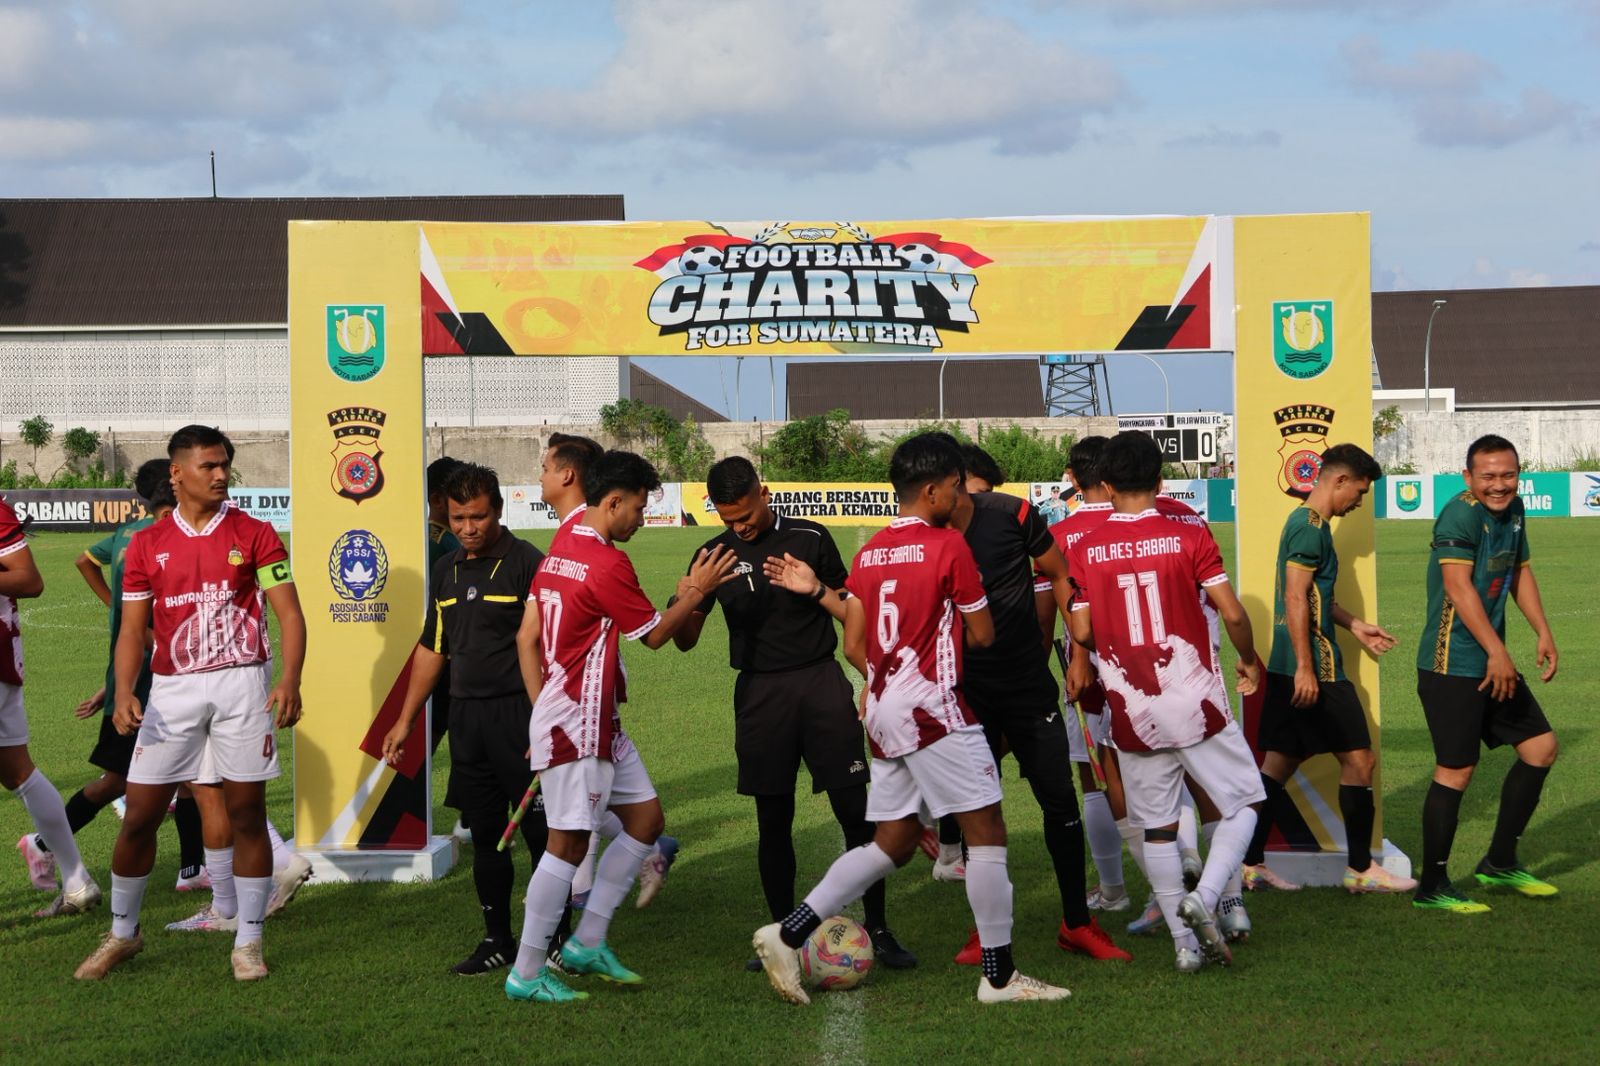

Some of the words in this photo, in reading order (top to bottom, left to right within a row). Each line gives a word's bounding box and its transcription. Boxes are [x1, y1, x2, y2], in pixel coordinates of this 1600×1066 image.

[723, 243, 902, 269] FOOTBALL
[647, 270, 980, 326] CHARITY
[686, 324, 751, 350] FOR
[758, 320, 943, 349] SUMATERA
[332, 365, 350, 380] KOTA
[351, 365, 381, 381] SABANG
[1279, 363, 1297, 377] KOTA
[1298, 362, 1328, 379] SABANG
[332, 408, 382, 418] POLRES
[337, 414, 377, 423] SABANG
[1278, 406, 1330, 417] POLRES
[1283, 412, 1325, 420] SABANG
[1176, 416, 1210, 425] RAJAWALI
[1212, 416, 1221, 424] FC
[338, 428, 376, 436] ACEH
[1286, 426, 1325, 434] ACEH
[1157, 437, 1178, 454] VS
[1201, 432, 1213, 457] 0
[258, 496, 290, 509] DIV
[826, 491, 889, 503] BERSATU
[14, 501, 90, 521] SABANG
[346, 548, 371, 558] PSSI
[860, 548, 888, 569] POLRES
[888, 544, 925, 564] SABANG
[1087, 542, 1133, 565] POLRES
[1135, 536, 1181, 558] SABANG
[271, 564, 288, 582] C
[557, 558, 589, 582] SABANG
[329, 603, 366, 612] ASOSIASI
[368, 603, 389, 612] KOTA
[1116, 570, 1167, 647] 11
[333, 613, 351, 622] PSSI
[353, 613, 386, 622] SABANG
[877, 579, 900, 654] 6
[262, 734, 272, 760] 4
